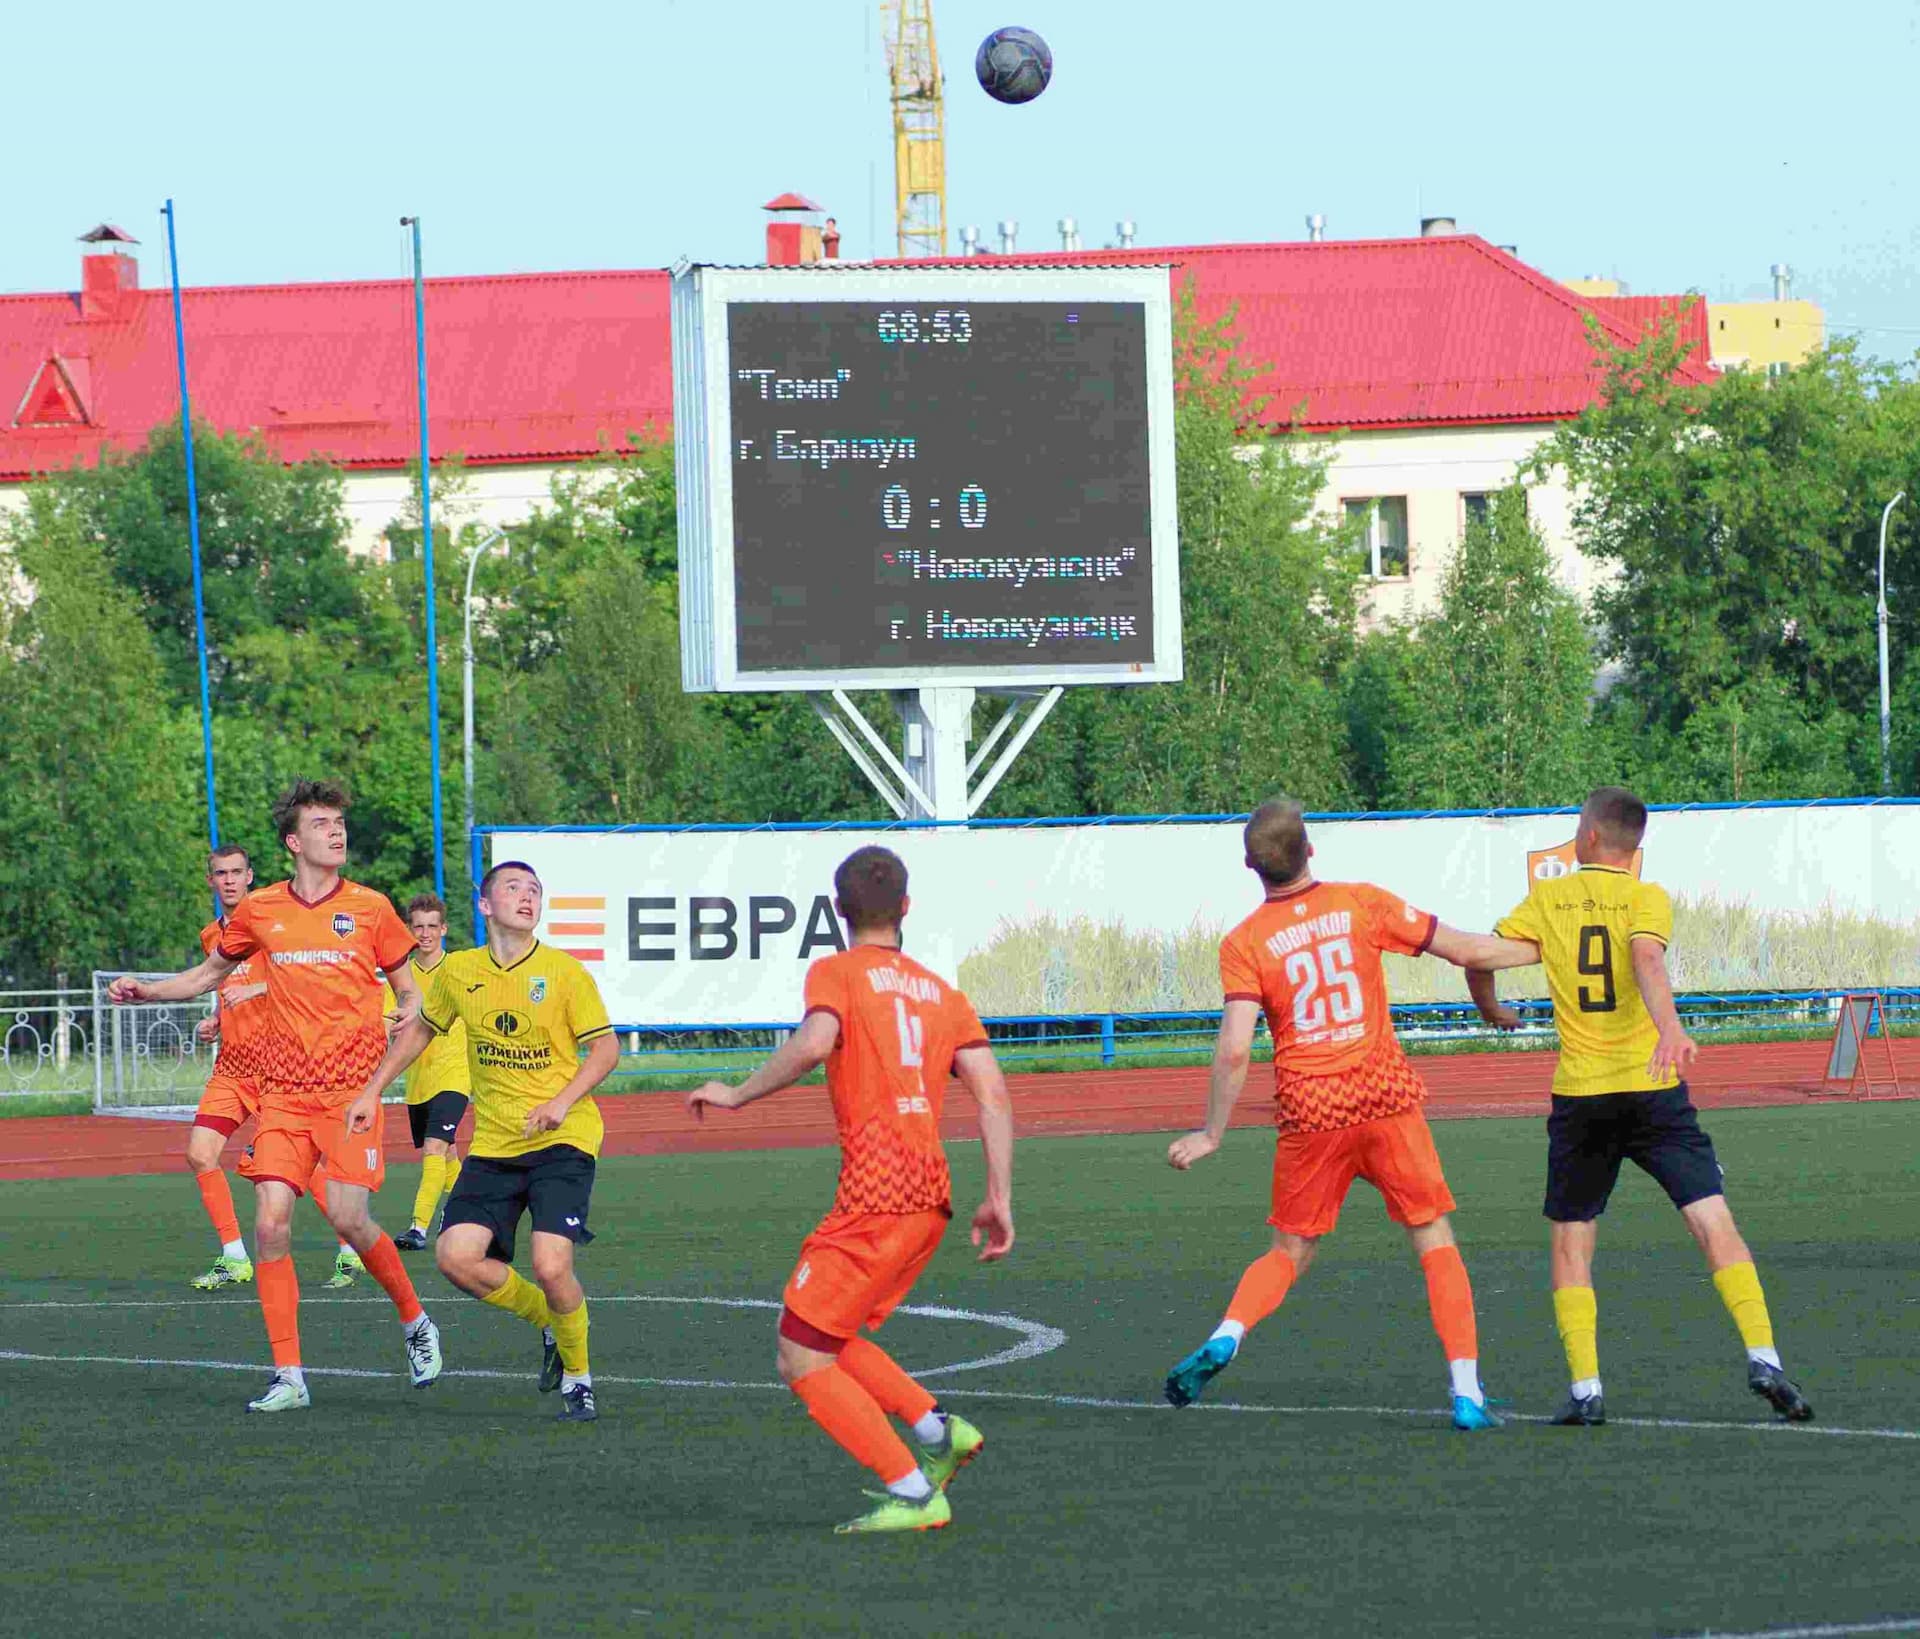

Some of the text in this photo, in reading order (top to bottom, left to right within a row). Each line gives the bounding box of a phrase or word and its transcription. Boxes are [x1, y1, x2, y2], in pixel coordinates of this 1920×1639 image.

[877, 310, 972, 343] 68:53
[628, 895, 903, 961] ЕВРА
[1285, 937, 1364, 1032] 25
[1578, 924, 1616, 1013] 9
